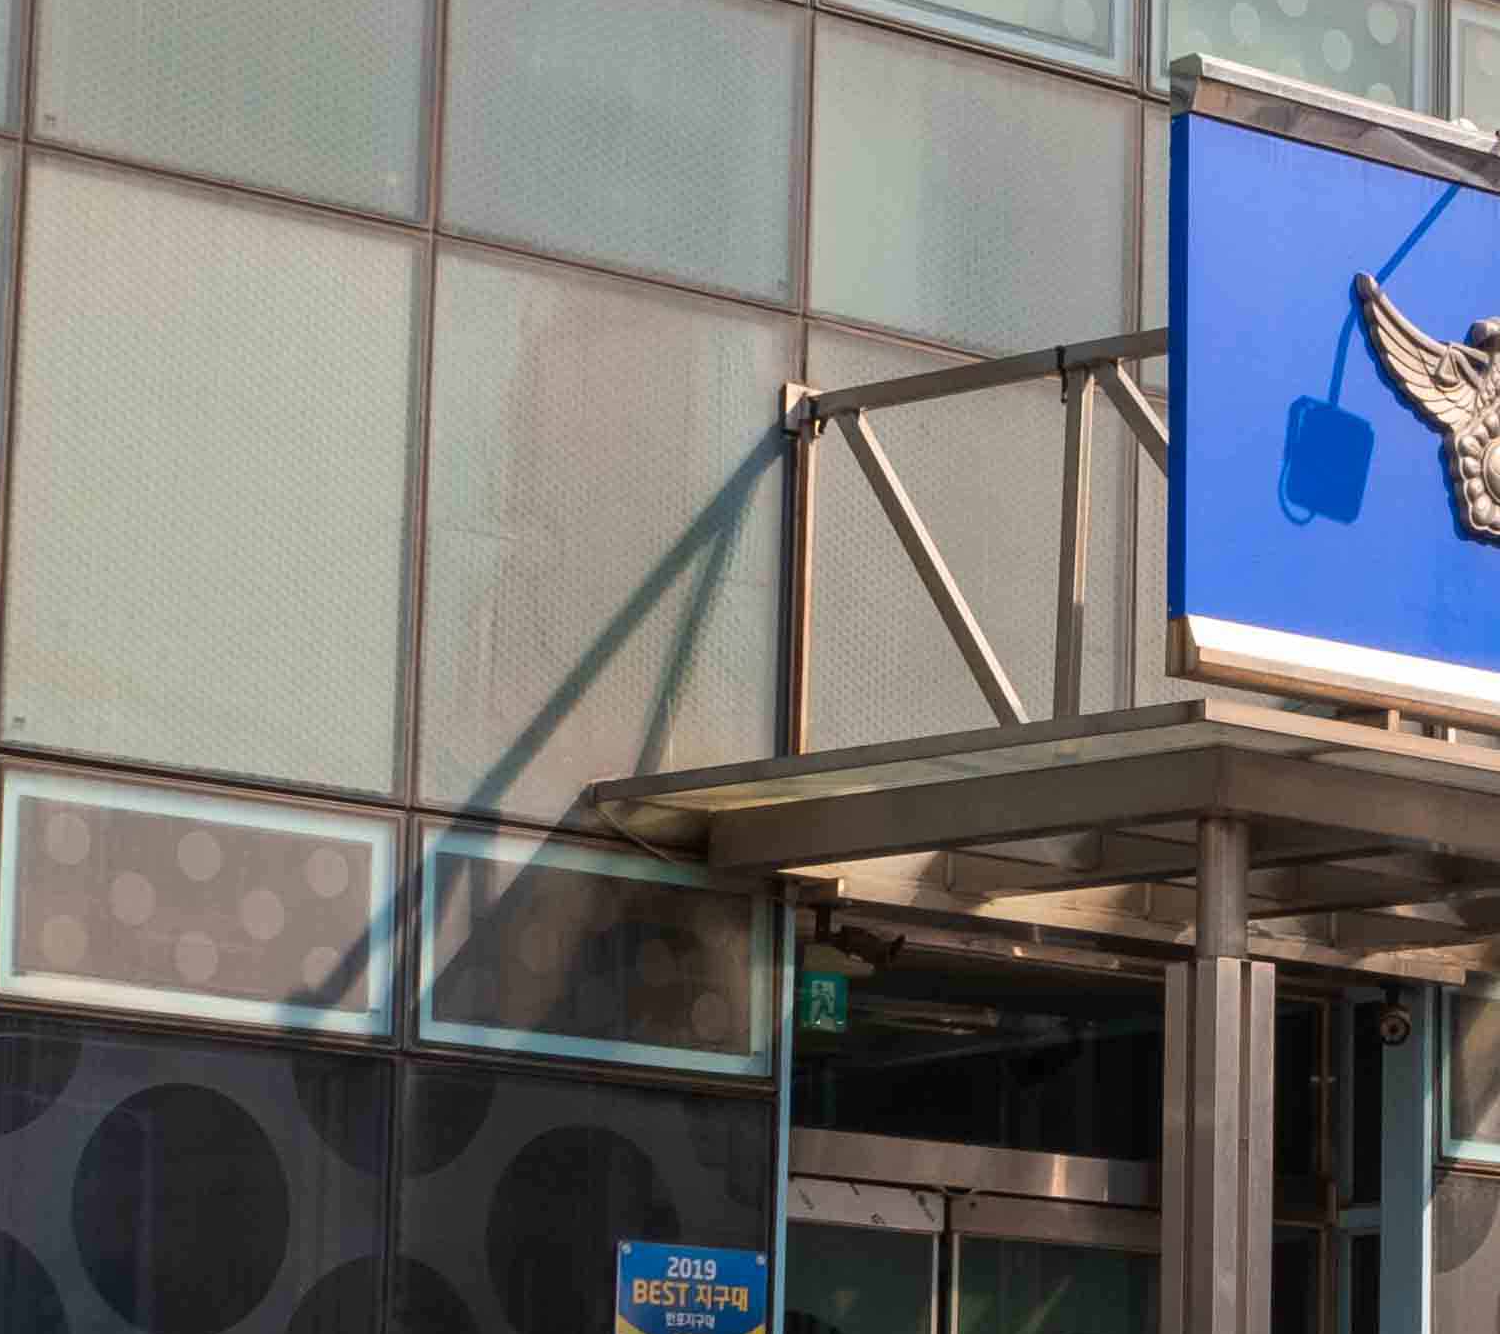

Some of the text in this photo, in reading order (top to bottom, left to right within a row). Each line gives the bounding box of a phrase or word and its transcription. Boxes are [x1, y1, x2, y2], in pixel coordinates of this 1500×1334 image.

[666, 1256, 717, 1280] 2019
[632, 1278, 749, 1312] BEST 지구대
